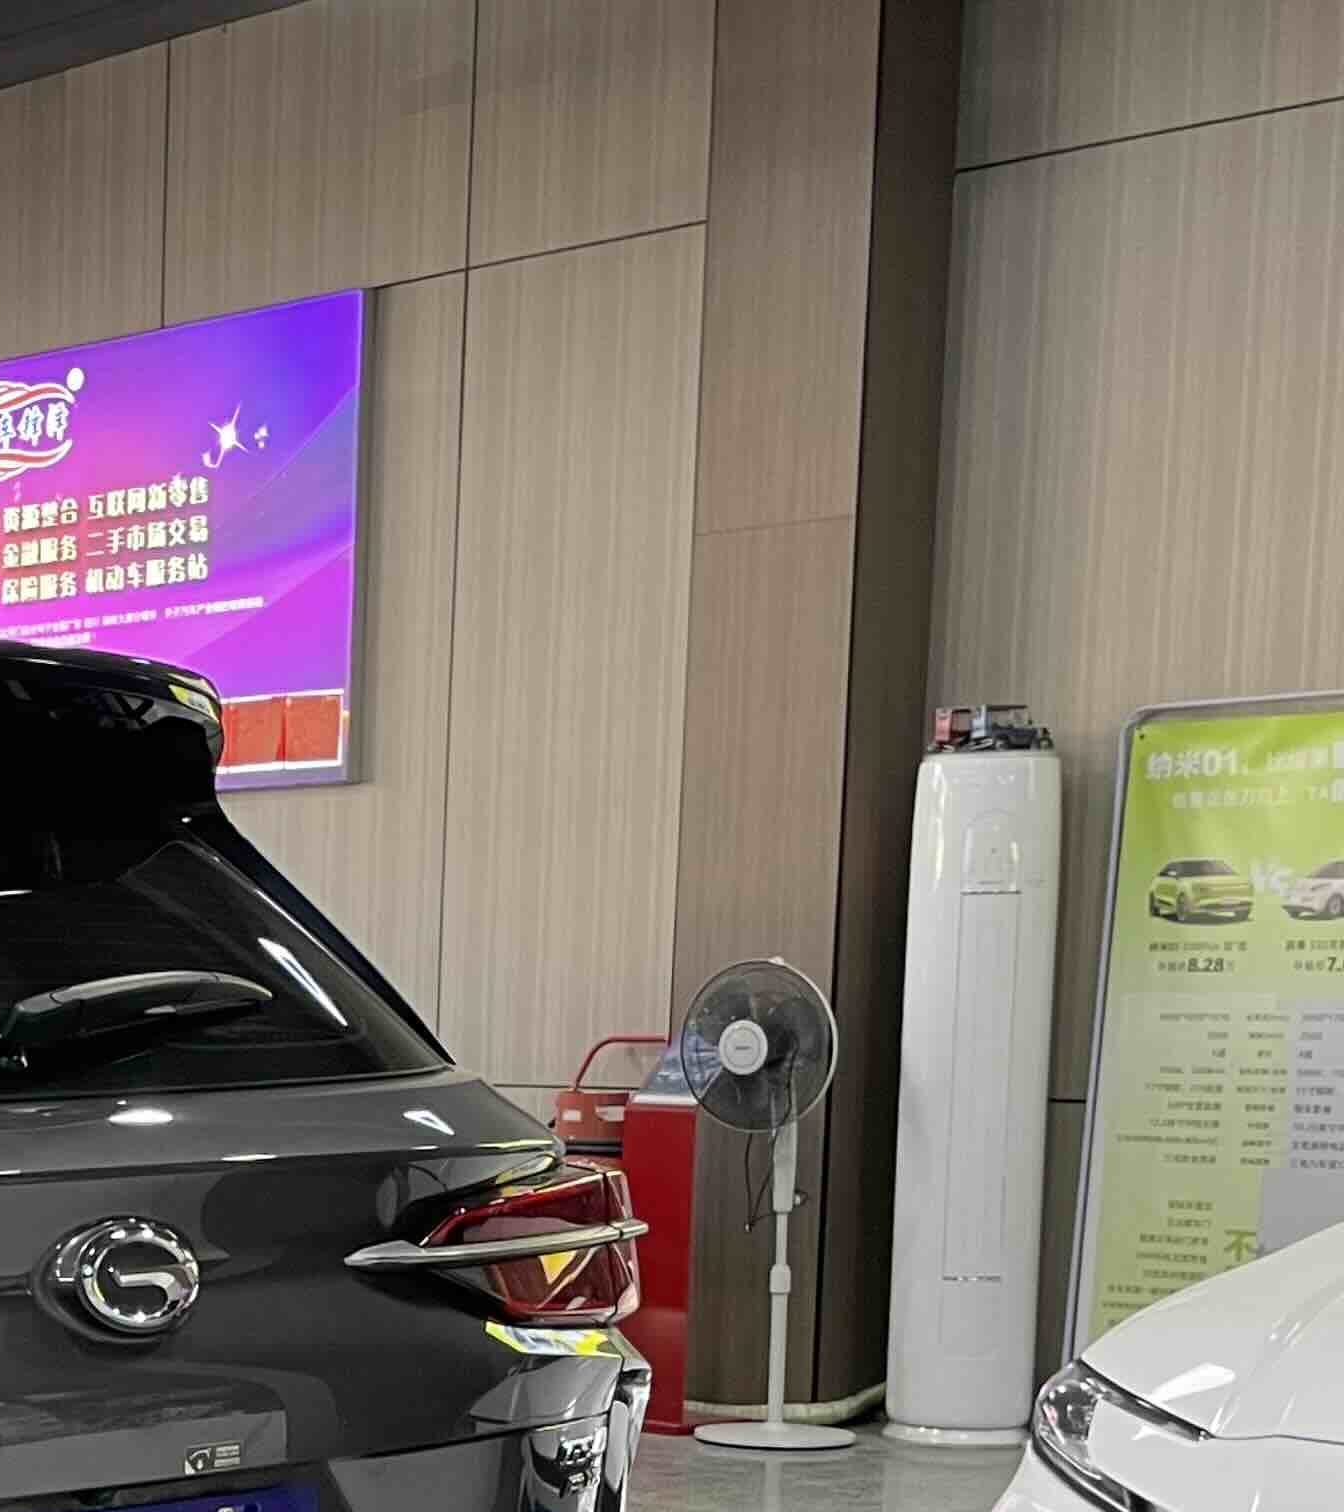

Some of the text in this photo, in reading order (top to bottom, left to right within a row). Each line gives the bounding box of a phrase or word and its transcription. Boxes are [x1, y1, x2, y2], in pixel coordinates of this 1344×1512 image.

[3, 498, 79, 533] 资源整合
[88, 476, 208, 520] 互联网新零售
[1, 535, 77, 569] 金融服务
[86, 515, 208, 556] 二手市场交易
[1, 571, 77, 604] 保险服务
[85, 553, 207, 593] 机动车服务站
